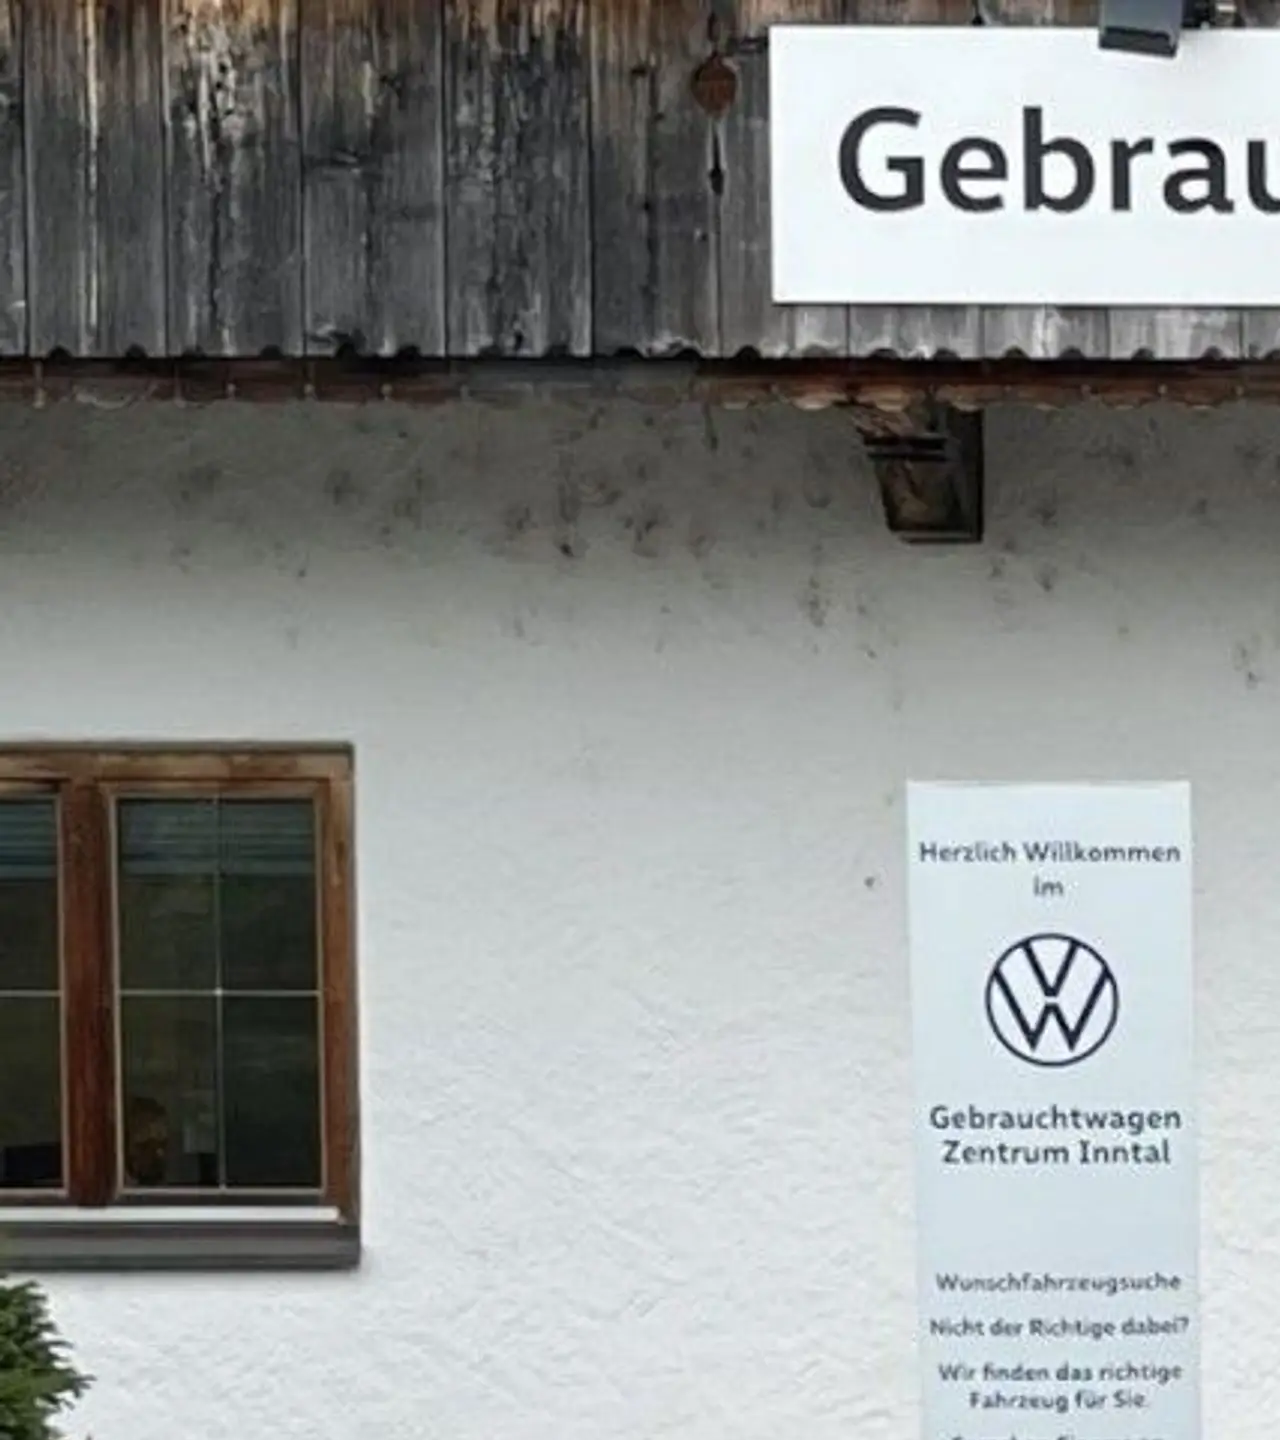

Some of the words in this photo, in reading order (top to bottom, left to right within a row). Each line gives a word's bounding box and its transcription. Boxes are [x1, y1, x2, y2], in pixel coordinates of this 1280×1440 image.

[918, 840, 1017, 863] Herzlich
[1022, 840, 1181, 863] Willkommen
[1032, 875, 1065, 897] im
[929, 1103, 1182, 1134] Gebrauchtwagen
[941, 1139, 1070, 1165] Zentrum
[1078, 1138, 1171, 1165] Inntal
[935, 1271, 1182, 1297] Wunschfahrzeugsuche
[929, 1316, 985, 1338] Nicht
[988, 1317, 1024, 1338] der
[1028, 1317, 1117, 1342] Richtige
[1120, 1315, 1190, 1337] dabei?
[937, 1363, 977, 1382] Wir
[981, 1361, 1051, 1382] finden
[1055, 1361, 1094, 1382] das
[1098, 1360, 1184, 1386] richtige
[968, 1390, 1070, 1413] Fahrzeug
[1074, 1389, 1108, 1410] für
